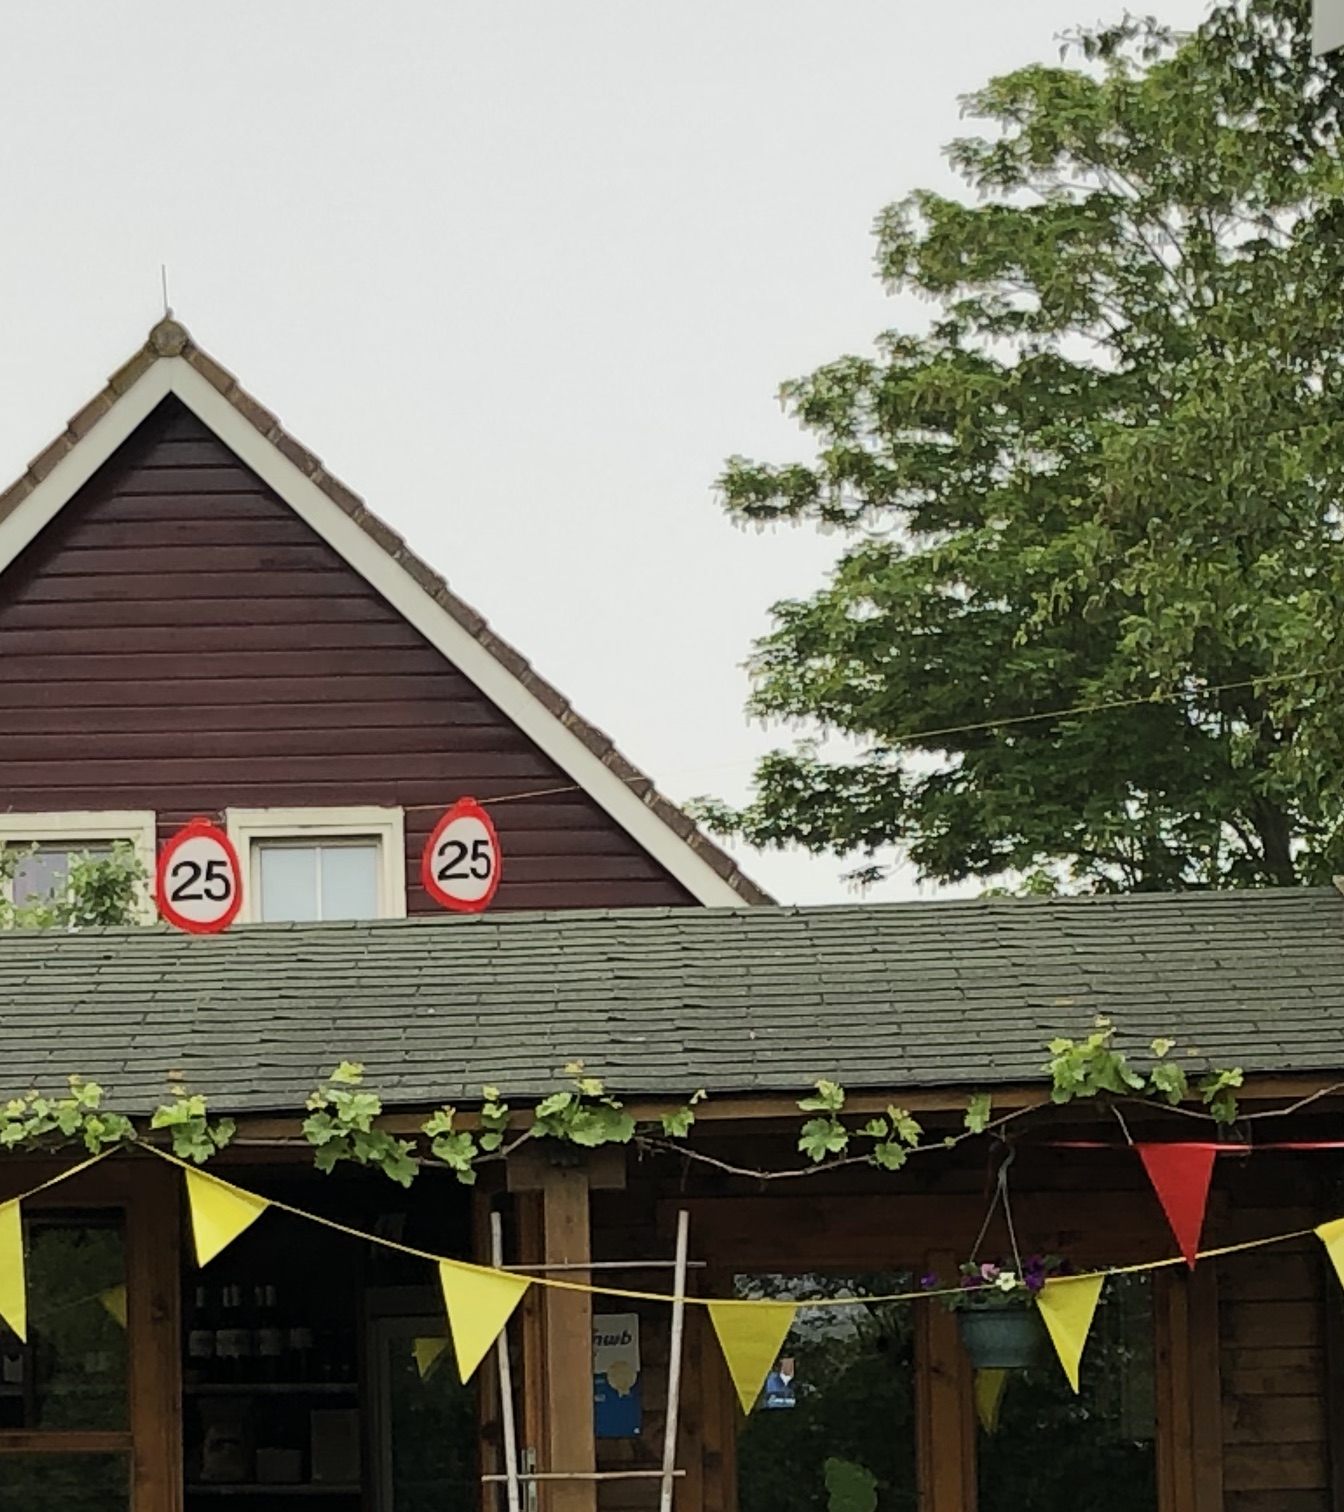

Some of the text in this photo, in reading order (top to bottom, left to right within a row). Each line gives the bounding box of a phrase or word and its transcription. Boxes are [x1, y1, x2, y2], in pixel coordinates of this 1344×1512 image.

[437, 839, 491, 880] 25
[170, 860, 231, 902] 25
[593, 1330, 632, 1347] nwb
